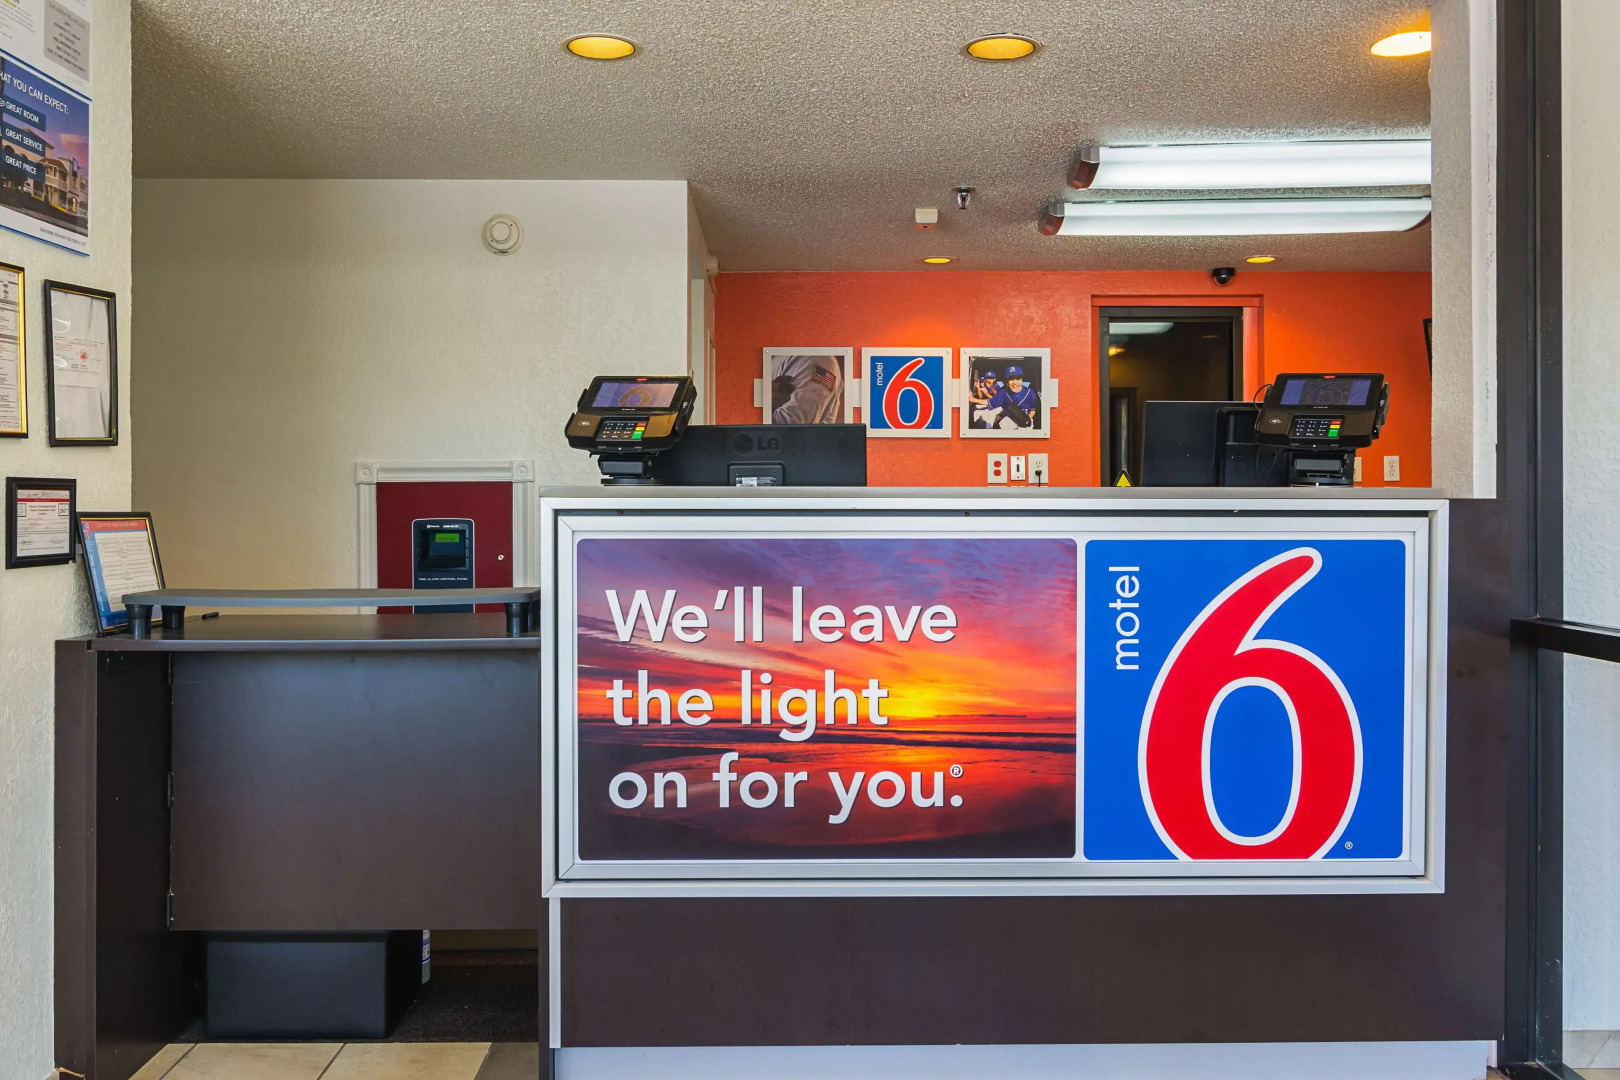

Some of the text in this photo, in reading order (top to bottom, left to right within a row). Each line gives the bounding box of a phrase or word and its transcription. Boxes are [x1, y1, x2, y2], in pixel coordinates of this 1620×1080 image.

[6, 101, 39, 123] GREAT ROOM
[12, 77, 27, 93] YOU
[28, 86, 43, 101] CAN
[44, 94, 69, 115] EXPECT:
[5, 128, 43, 152] GREAT SERVICE
[5, 155, 37, 175] GREAT PRICE
[876, 357, 934, 429] motel 6
[757, 437, 780, 450] LG
[605, 586, 958, 643] We'll leave
[606, 670, 890, 741] the light
[1109, 547, 1363, 859] motel 6
[608, 770, 688, 809] on
[712, 752, 808, 809] for
